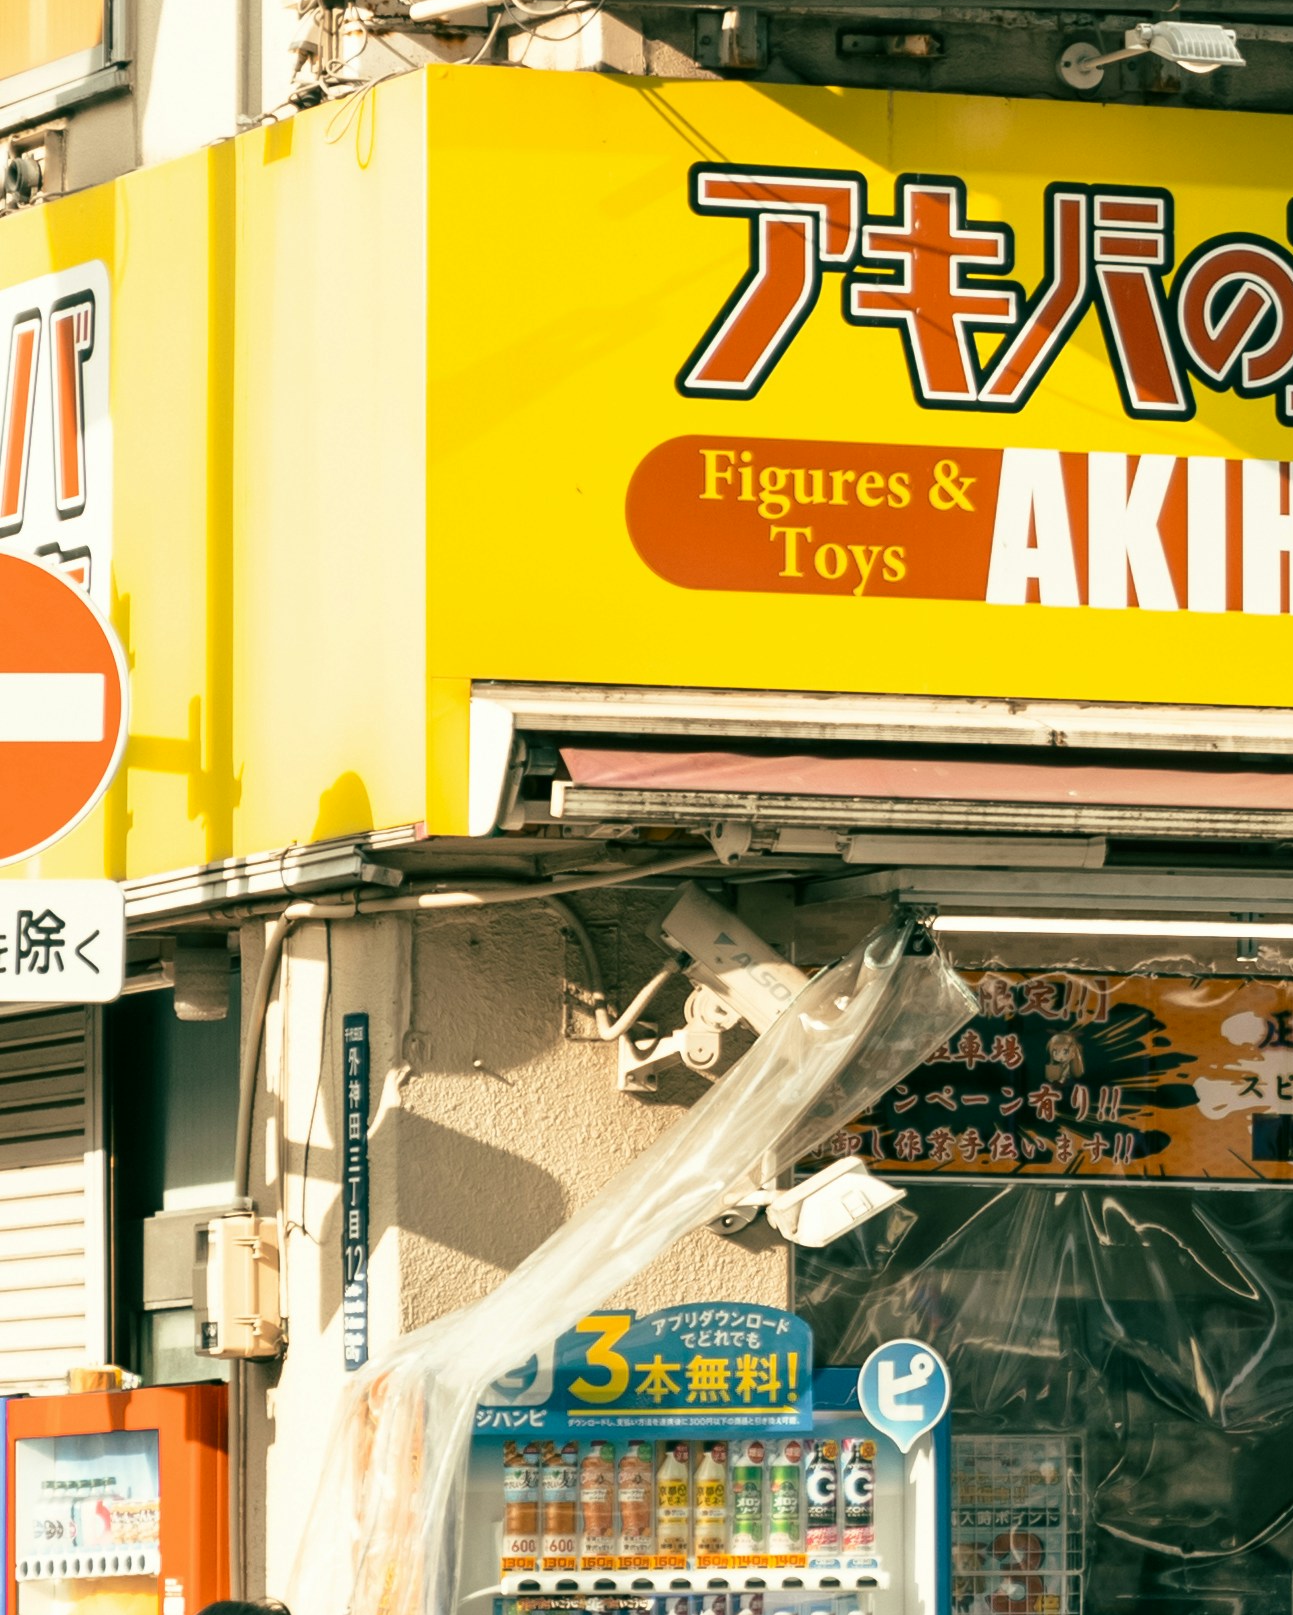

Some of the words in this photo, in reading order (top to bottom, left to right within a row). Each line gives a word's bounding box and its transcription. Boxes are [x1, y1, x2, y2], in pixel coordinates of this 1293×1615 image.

[698, 448, 912, 512] Figures
[927, 460, 977, 512] &
[770, 525, 907, 596] Toys
[862, 1084, 1121, 1123] ンペーン有り!!
[651, 1310, 791, 1337] アプリダウンロード
[680, 1329, 762, 1350] でどれでも
[568, 1314, 800, 1404] 3本無料!
[877, 1352, 934, 1422] ピ
[476, 1409, 547, 1427] ジハンピ
[511, 1539, 537, 1552] 600
[550, 1539, 573, 1552] 600
